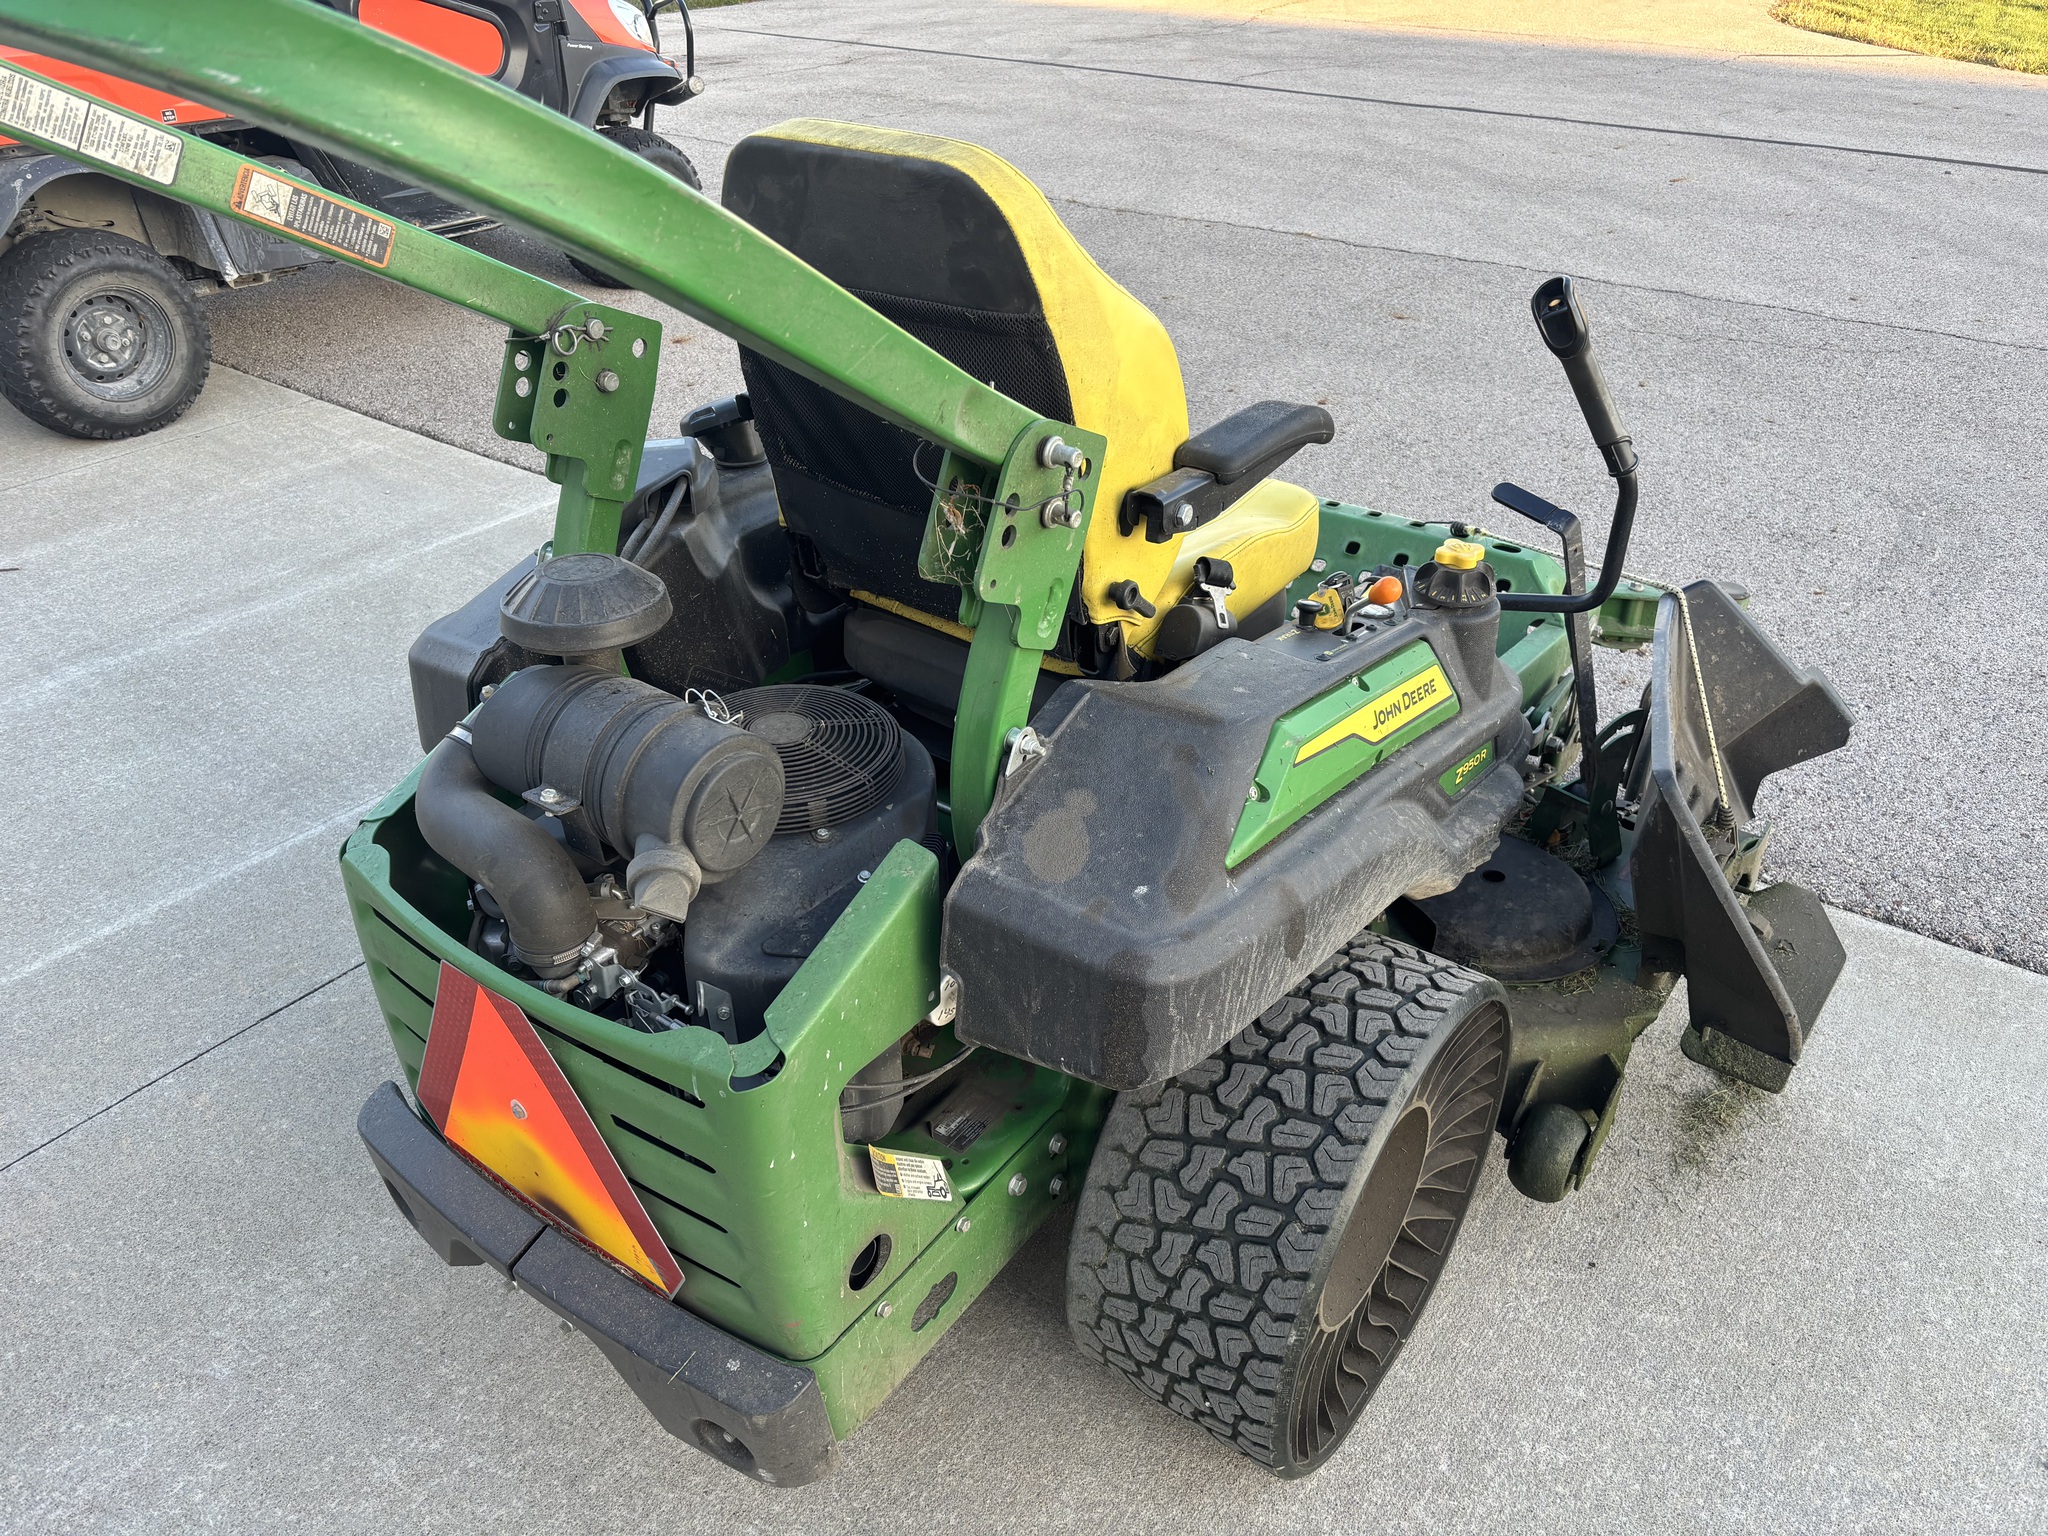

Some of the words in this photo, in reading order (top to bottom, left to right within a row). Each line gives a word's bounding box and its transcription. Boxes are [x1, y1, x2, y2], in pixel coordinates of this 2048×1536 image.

[238, 168, 250, 201] ADVERTENCIA
[294, 193, 308, 229] APLASTADURAS
[1373, 700, 1402, 730] JOHN
[1402, 679, 1437, 710] DEERE
[1455, 749, 1487, 785] Z950R
